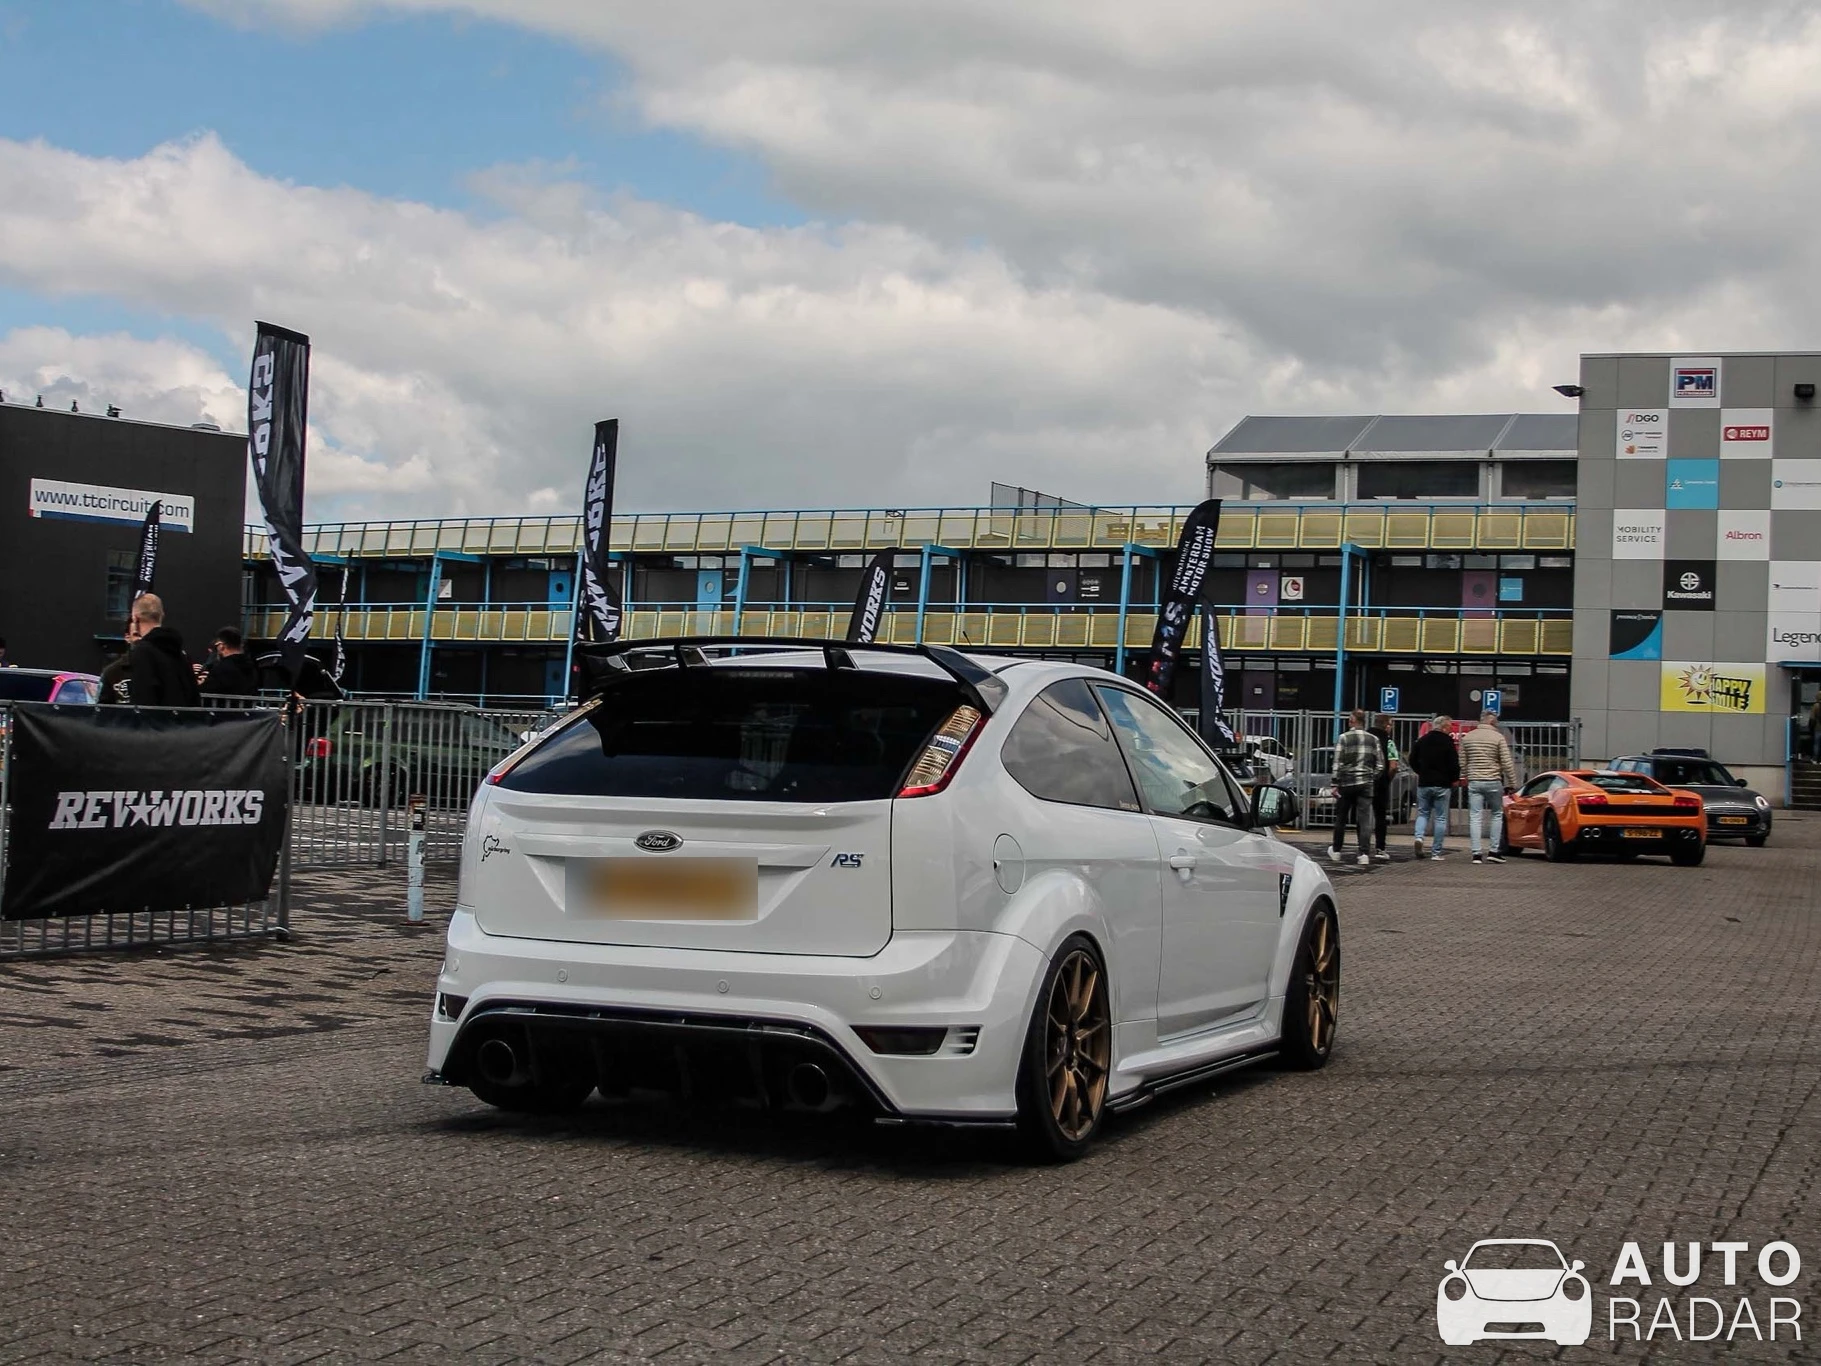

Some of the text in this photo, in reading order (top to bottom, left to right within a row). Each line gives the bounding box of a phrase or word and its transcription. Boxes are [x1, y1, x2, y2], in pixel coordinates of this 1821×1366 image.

[1678, 375, 1713, 390] PM
[1635, 414, 1659, 423] DGO
[1739, 429, 1767, 438] REYM
[35, 490, 190, 518] www.ttcircuitcom
[1725, 531, 1763, 540] Albron
[1178, 525, 1206, 594] AMSTERDAM
[1187, 527, 1214, 596] MOTOR SHOW
[1667, 590, 1712, 599] Kawasaki
[858, 566, 886, 643] WORKS
[1384, 689, 1395, 703] P
[1486, 692, 1497, 706] P
[644, 834, 671, 847] Ford
[830, 853, 865, 868] RS
